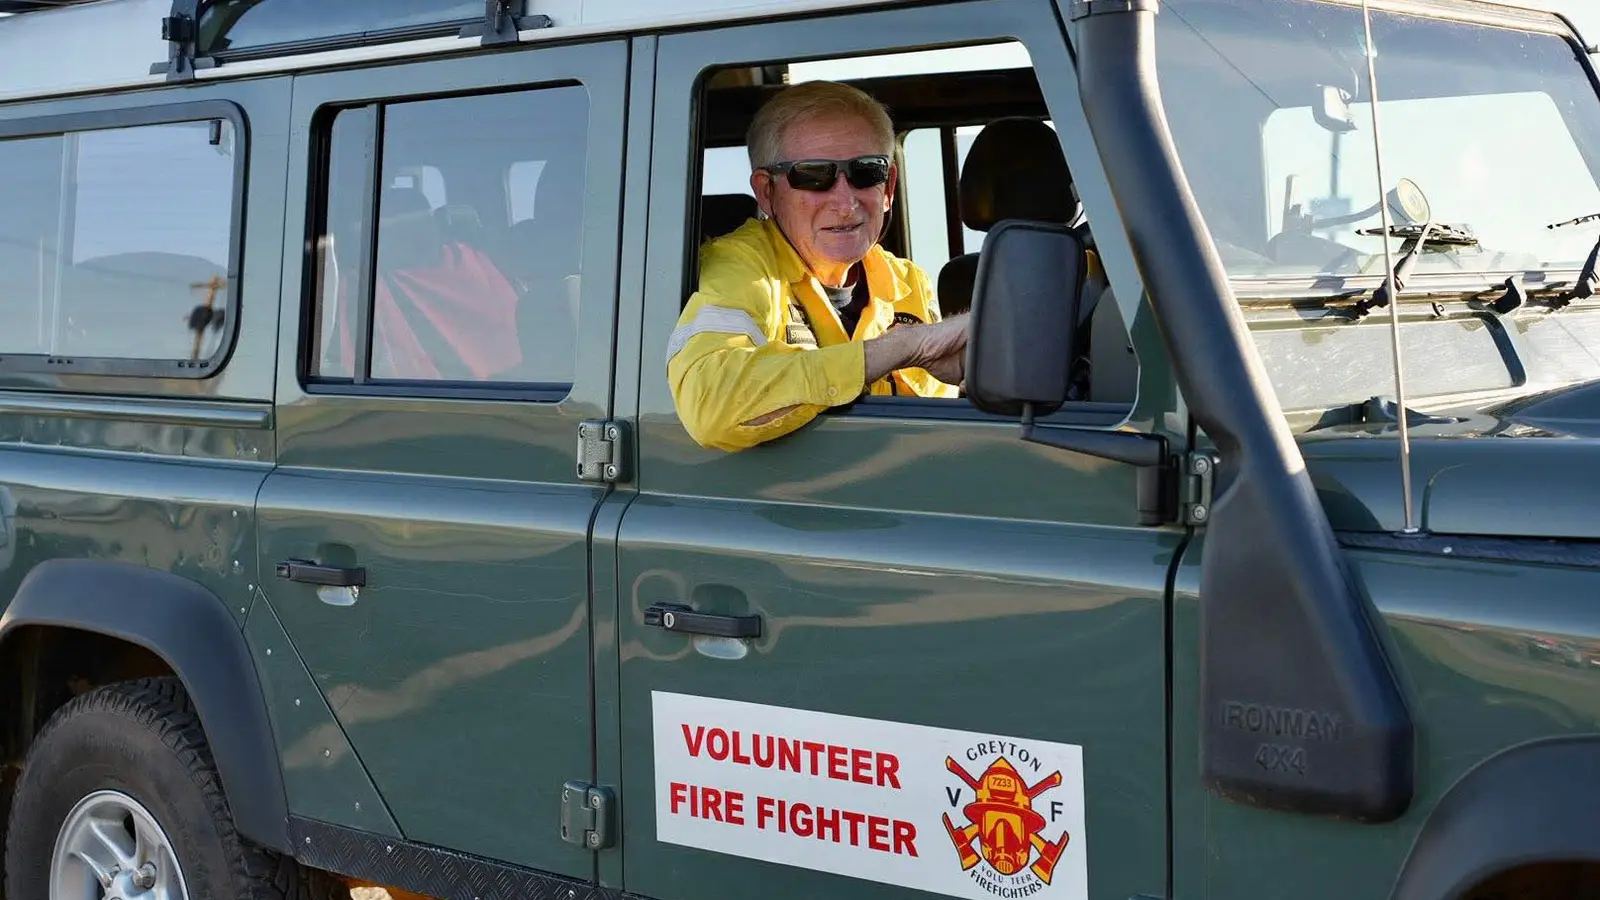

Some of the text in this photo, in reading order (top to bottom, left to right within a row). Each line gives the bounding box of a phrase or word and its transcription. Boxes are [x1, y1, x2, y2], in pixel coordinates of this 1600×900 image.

[1222, 701, 1341, 741] IRONMAN
[681, 724, 901, 789] VOLUNTEER
[966, 740, 1042, 772] GREYTON
[992, 777, 1012, 788] 7233
[669, 782, 919, 858] FIRE FIGHTER
[946, 787, 1063, 822] V F
[970, 869, 1043, 899] FIREFIGHTERS
